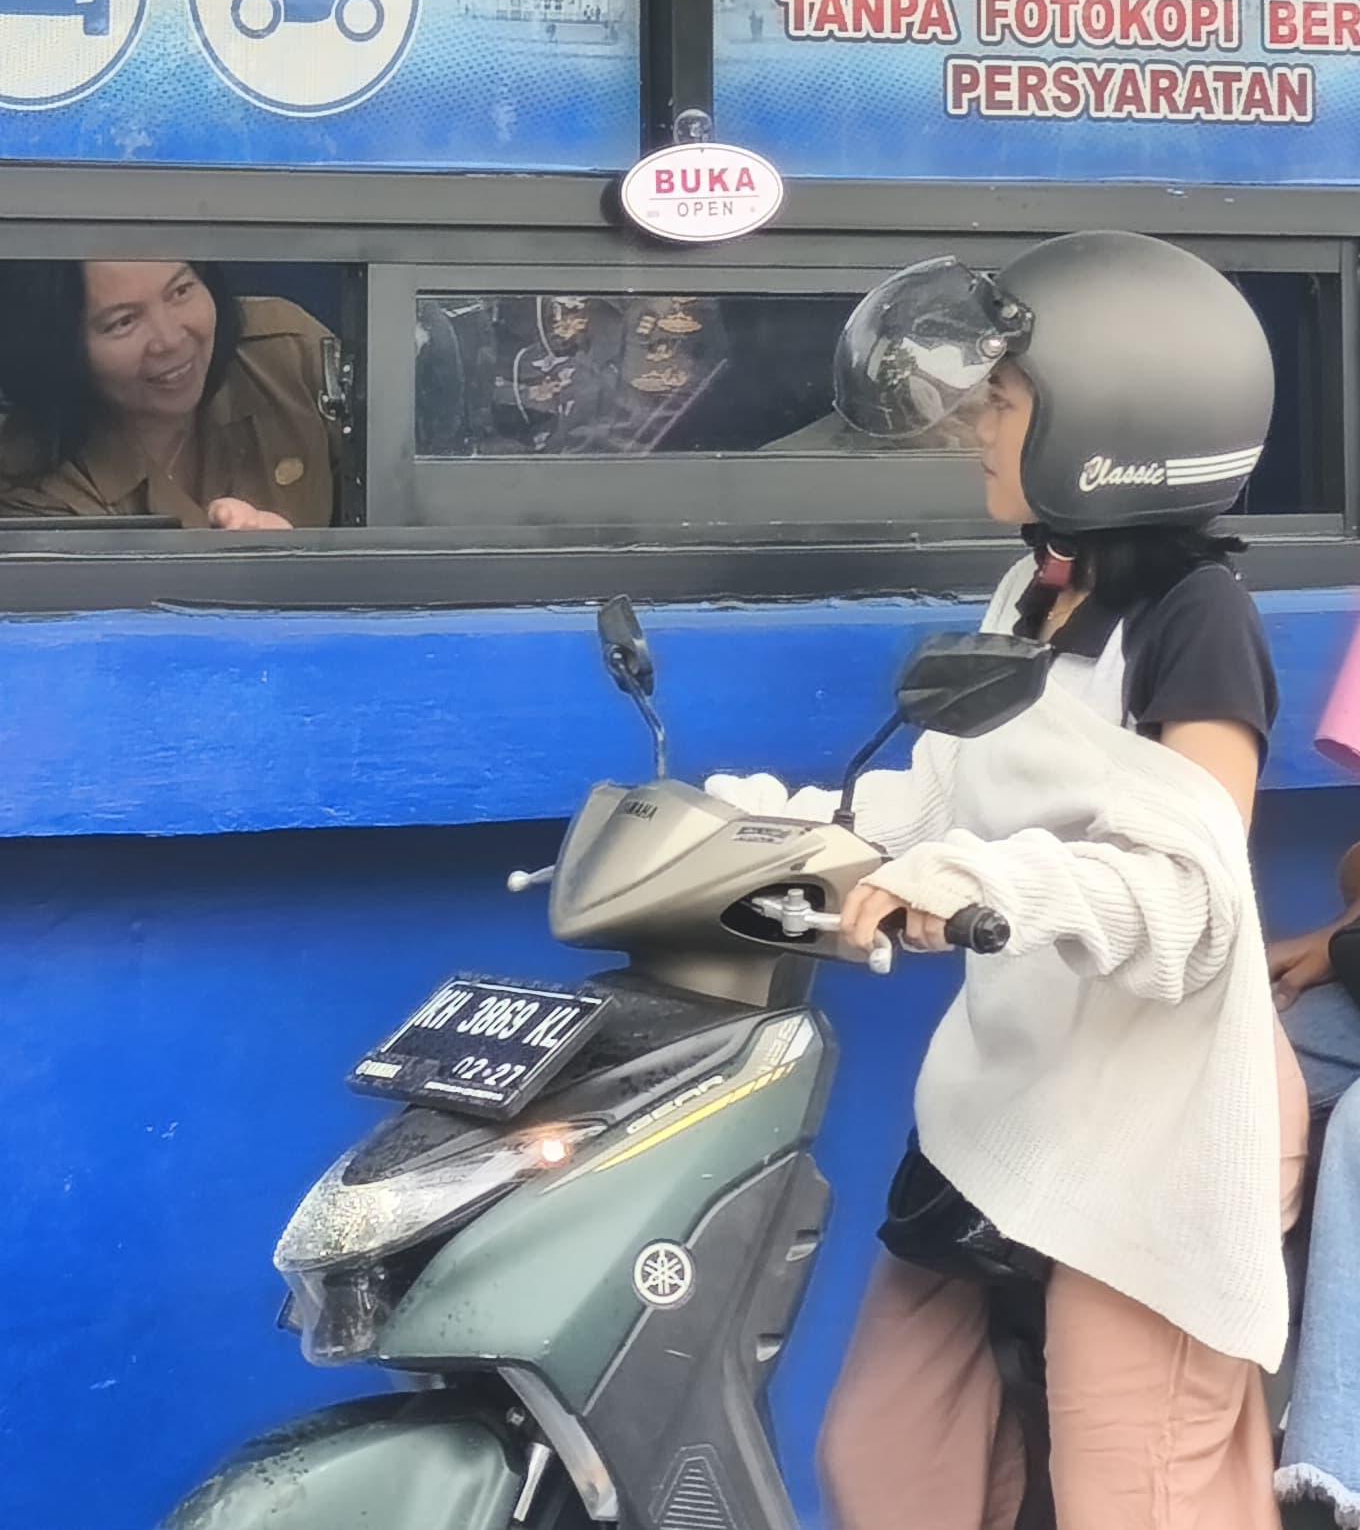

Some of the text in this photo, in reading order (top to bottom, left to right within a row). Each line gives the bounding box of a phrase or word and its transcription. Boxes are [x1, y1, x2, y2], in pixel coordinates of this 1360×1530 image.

[944, 57, 1315, 125] PERSYARATAN
[655, 166, 755, 194] BUKA
[677, 201, 734, 218] OPEN
[1078, 455, 1165, 492] Classic
[414, 990, 580, 1048] KH 3869 KL
